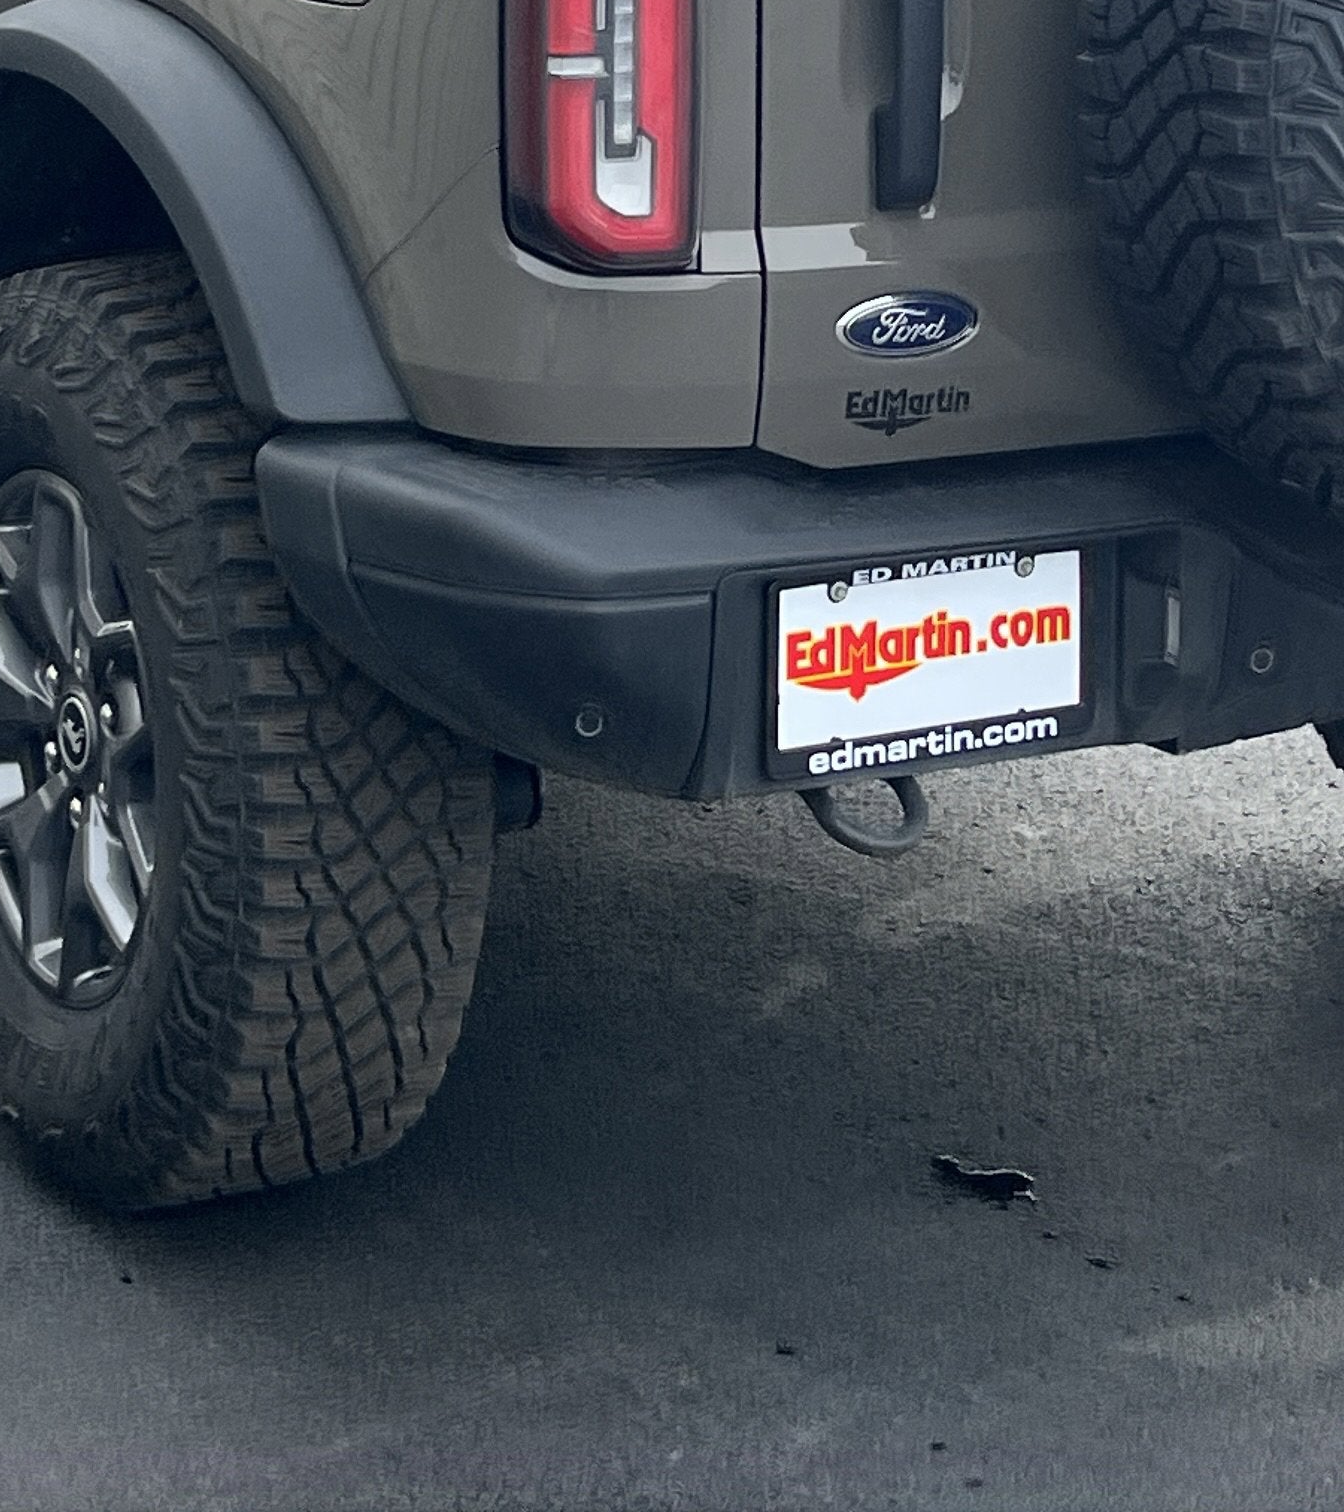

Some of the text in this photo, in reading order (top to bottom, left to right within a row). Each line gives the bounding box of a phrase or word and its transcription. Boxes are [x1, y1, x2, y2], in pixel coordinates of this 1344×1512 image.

[872, 307, 945, 345] Ford
[844, 386, 970, 424] EdMartin
[851, 551, 1017, 587] ED MARTIN
[785, 603, 1072, 684] EdMartin.com
[807, 714, 1059, 776] edmartin.com
